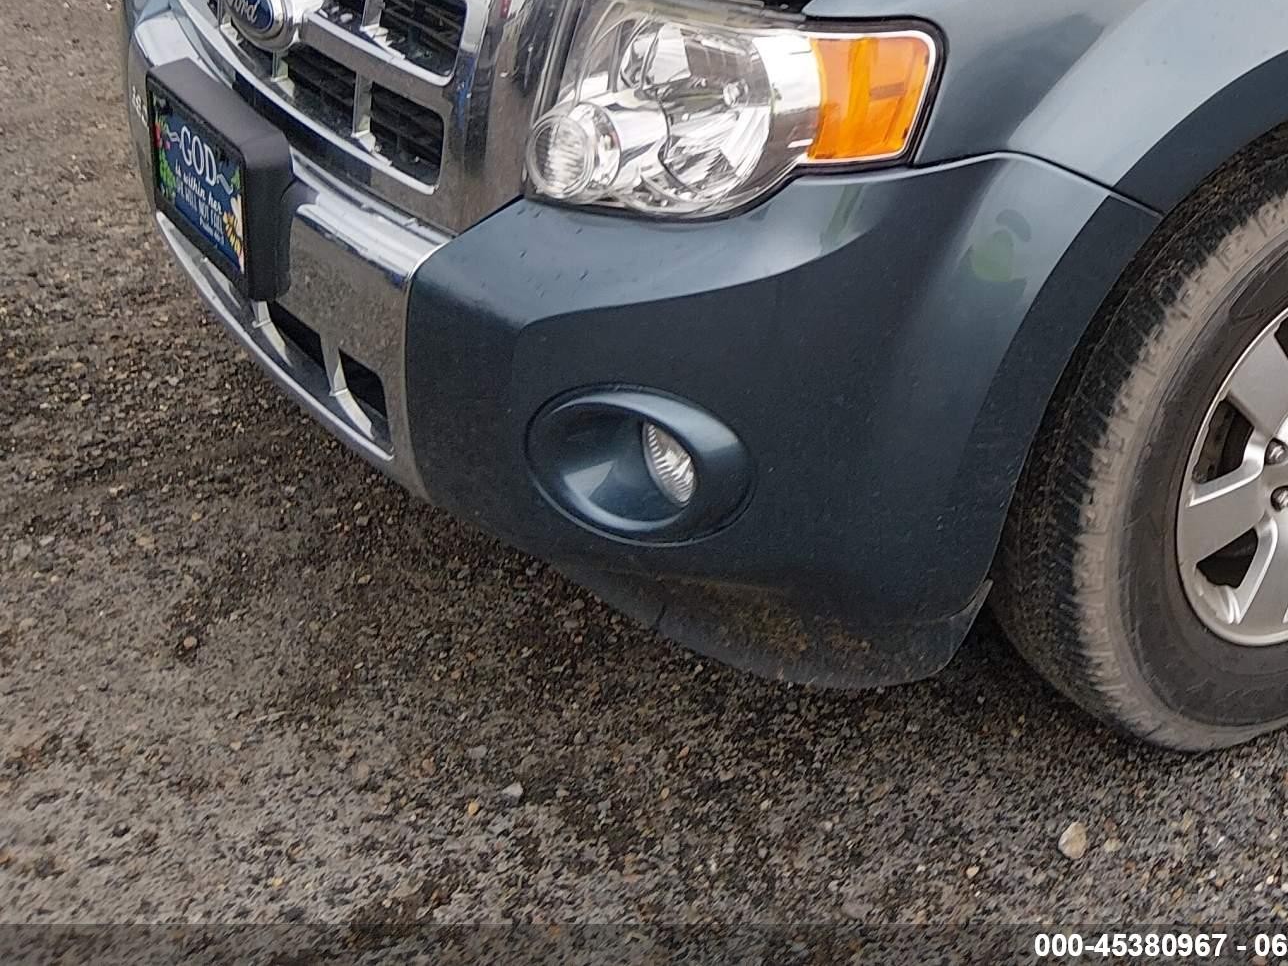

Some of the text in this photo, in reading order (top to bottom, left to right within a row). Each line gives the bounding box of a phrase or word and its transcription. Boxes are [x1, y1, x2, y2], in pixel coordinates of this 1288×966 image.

[180, 125, 217, 187] GOD
[183, 172, 206, 201] within
[208, 190, 222, 215] her
